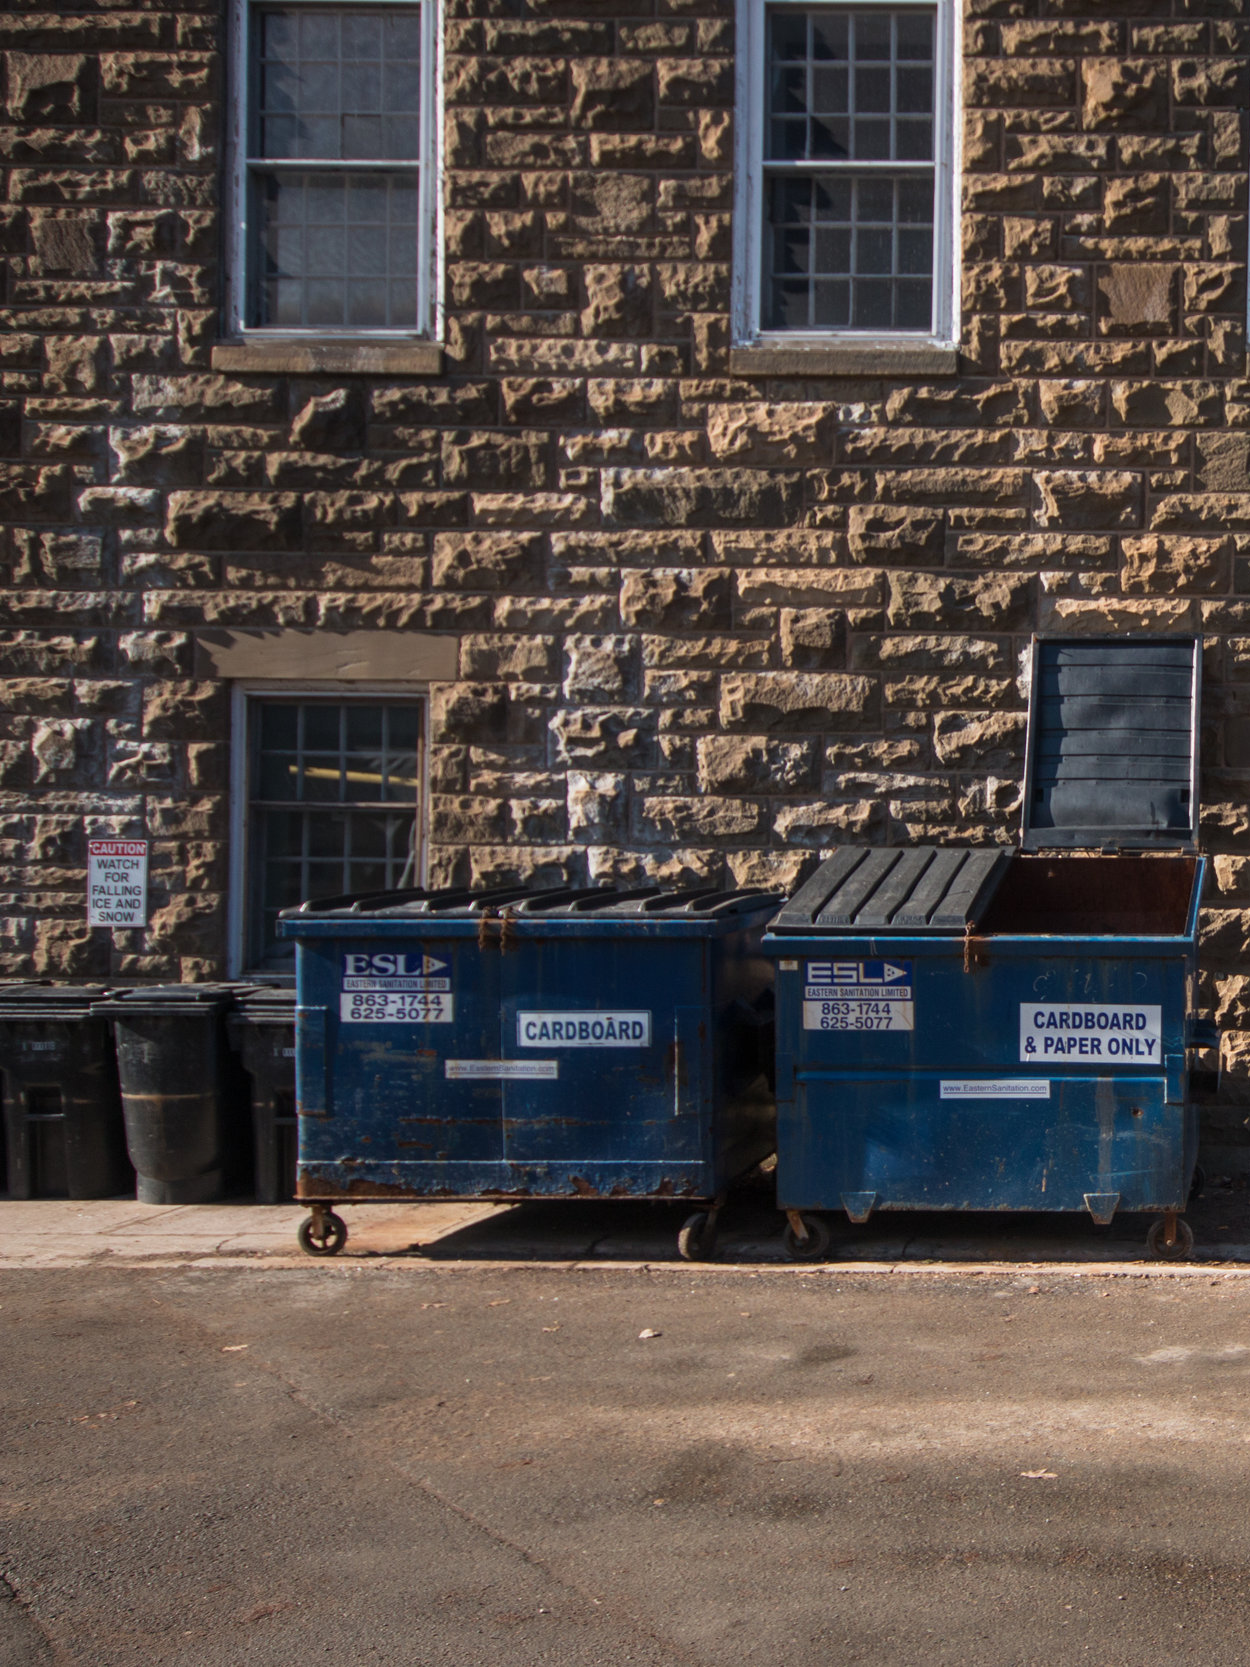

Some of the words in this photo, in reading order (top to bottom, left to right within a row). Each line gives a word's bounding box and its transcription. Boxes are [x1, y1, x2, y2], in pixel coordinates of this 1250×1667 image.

[92, 843, 144, 854] CAUTION
[97, 859, 139, 869] WATCH
[104, 872, 129, 882] FOR
[92, 885, 142, 896] FALLING
[92, 898, 110, 909] ICE
[116, 898, 141, 909] AND
[98, 911, 135, 922] SNOW
[344, 954, 421, 976] ESL
[807, 962, 883, 983] ESL
[346, 979, 377, 988] EASTERN
[379, 979, 418, 988] SANITATION
[420, 979, 447, 989] LIMITED
[807, 988, 838, 997] EASTERN
[840, 988, 879, 997] SANITATION
[881, 988, 909, 997] LIMITED
[352, 994, 442, 1007] 863-1744
[350, 1008, 444, 1020] 625-5077
[821, 1002, 891, 1015] 863-1744
[820, 1017, 893, 1029] 625-5077
[1033, 1011, 1147, 1031] CARDBOARD
[525, 1020, 644, 1041] CARDBOARD
[1024, 1036, 1037, 1054] &
[1044, 1037, 1102, 1055] PAPER
[1107, 1038, 1157, 1056] ONLY
[943, 1084, 1047, 1092] www.EasternSanitation.com
